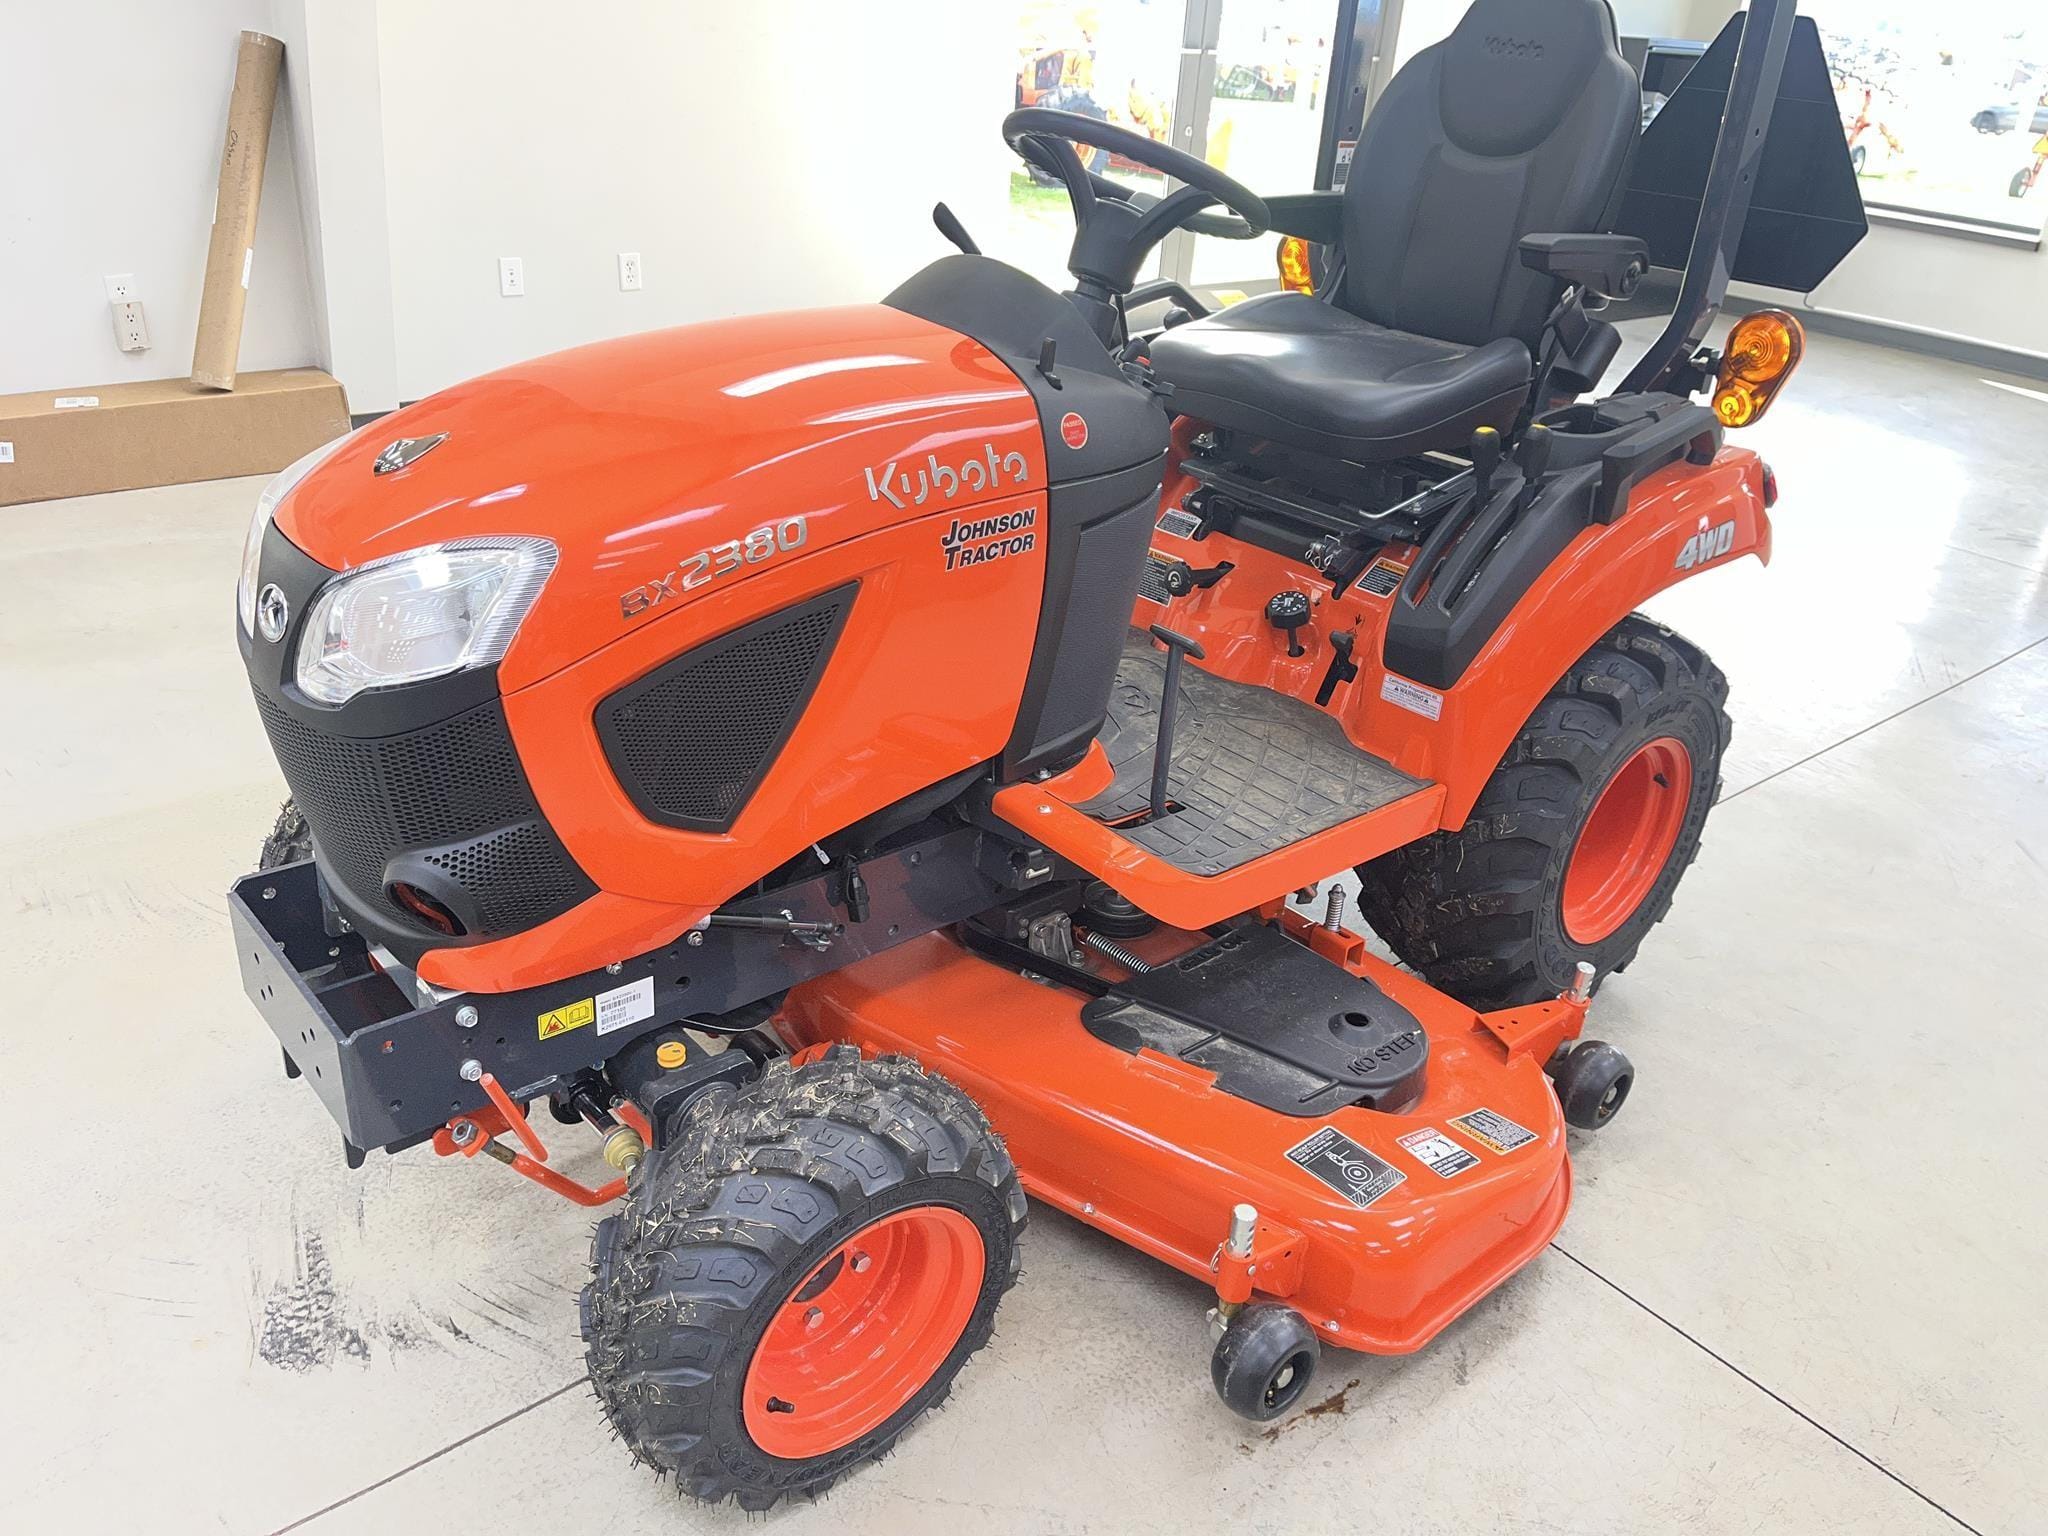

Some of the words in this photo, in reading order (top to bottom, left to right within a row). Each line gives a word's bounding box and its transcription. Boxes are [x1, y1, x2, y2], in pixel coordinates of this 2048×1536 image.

[865, 443, 1029, 509] Kubota
[941, 508, 1036, 547] JOHNSON
[1674, 519, 1735, 571] 4WD
[620, 515, 808, 621] BX2380
[944, 533, 1036, 571] TRACTOR
[1347, 1056, 1378, 1076] NO
[1374, 1031, 1416, 1061] STEP
[1408, 1128, 1440, 1146] DANGER
